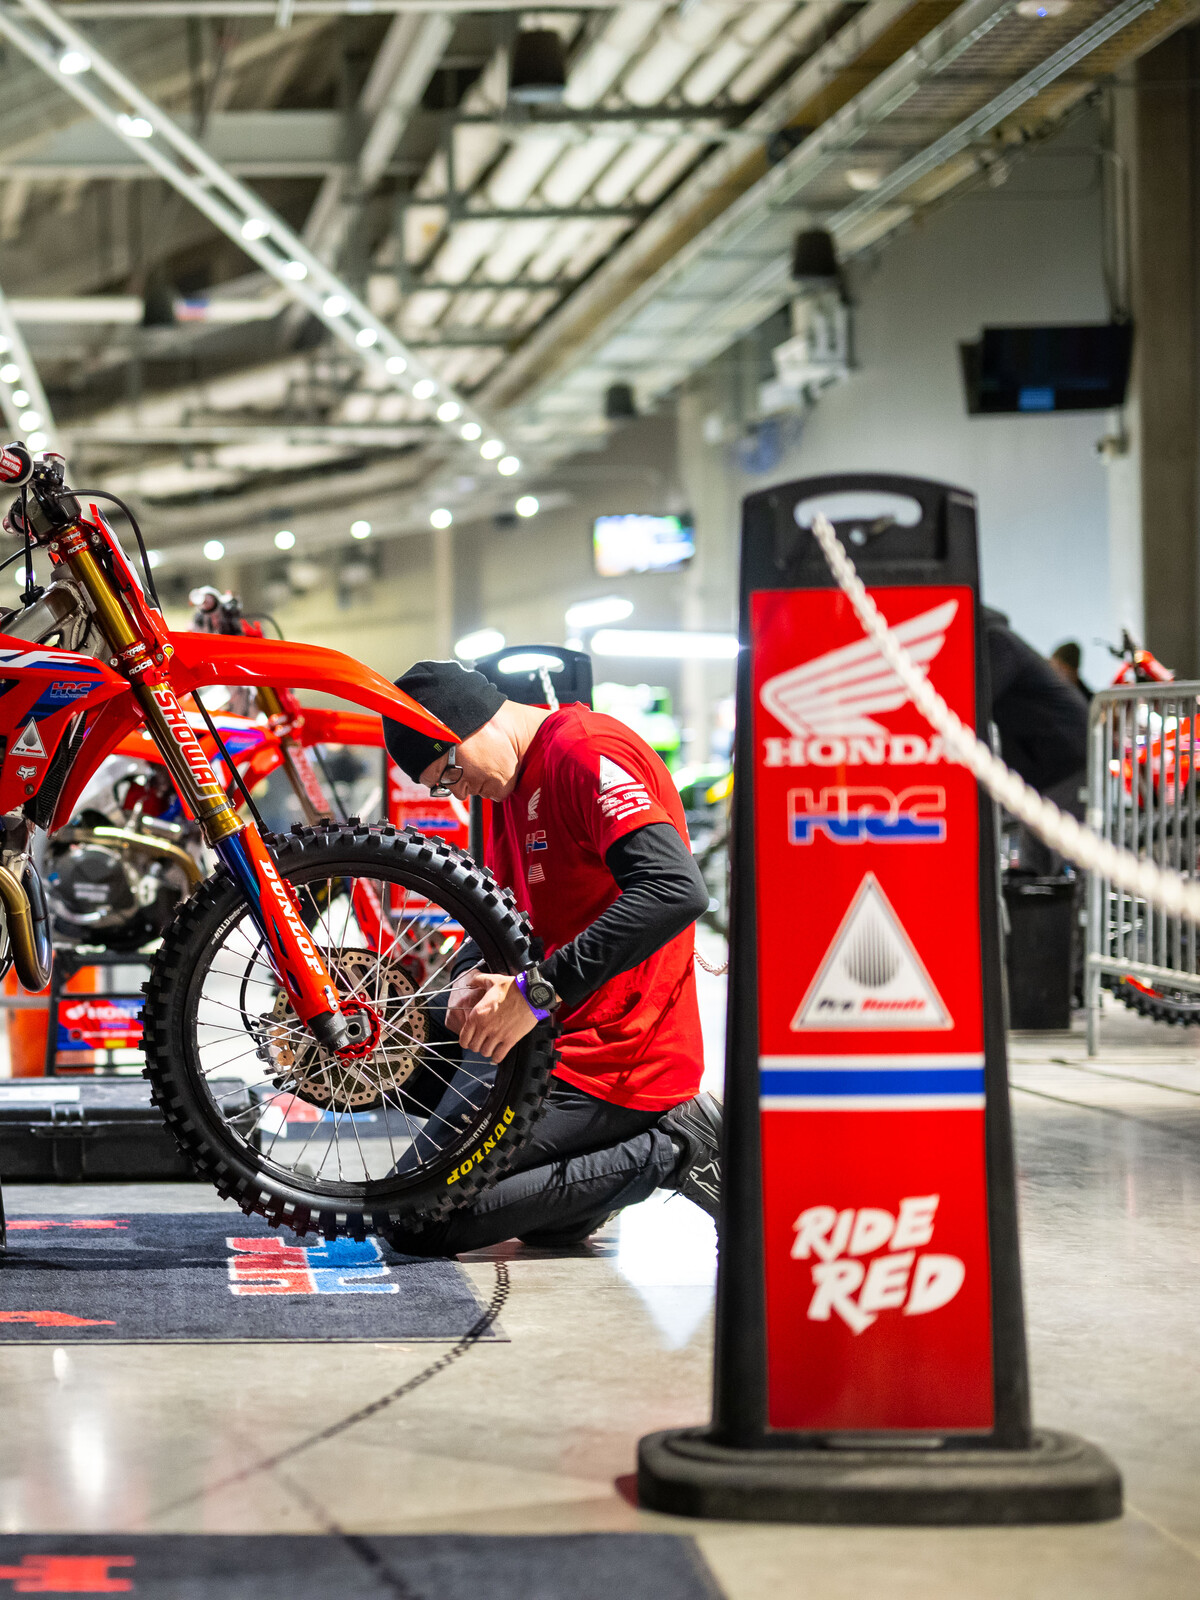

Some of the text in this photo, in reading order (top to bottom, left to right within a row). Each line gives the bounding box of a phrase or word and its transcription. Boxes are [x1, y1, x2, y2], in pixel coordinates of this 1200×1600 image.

[119, 642, 147, 660] XTRIG
[151, 690, 219, 787] SHOWA
[787, 785, 946, 845] HRC
[259, 859, 324, 976] DUNLOP
[446, 1105, 515, 1185] DUNLOP
[790, 1193, 940, 1263] RIDE
[807, 1249, 966, 1336] RED
